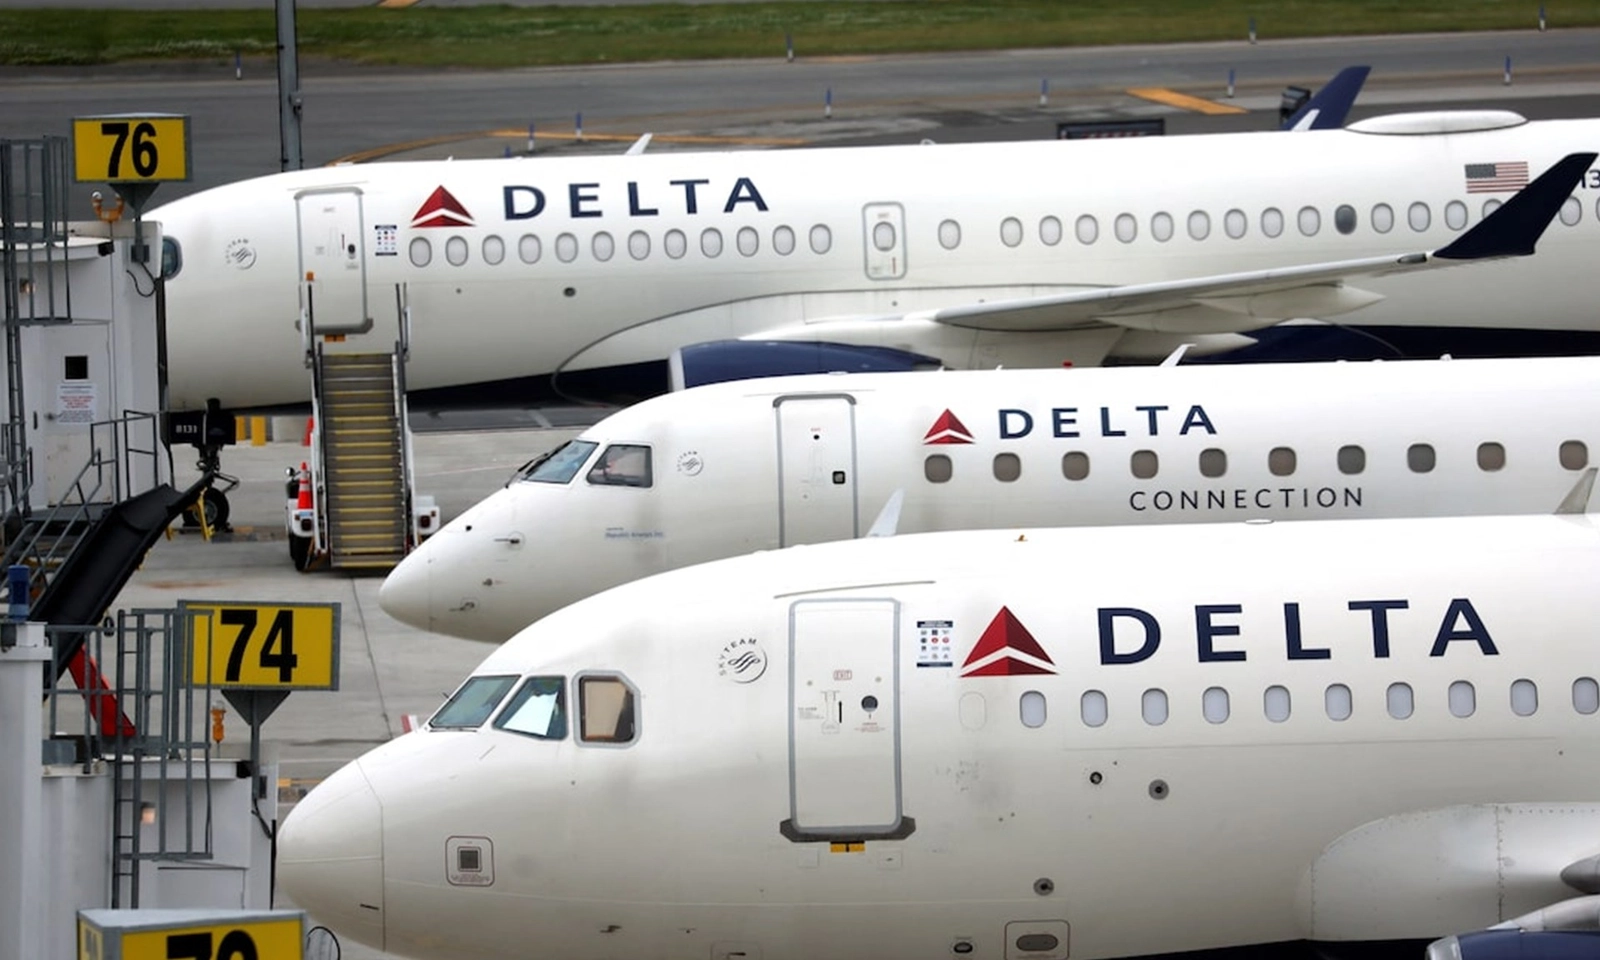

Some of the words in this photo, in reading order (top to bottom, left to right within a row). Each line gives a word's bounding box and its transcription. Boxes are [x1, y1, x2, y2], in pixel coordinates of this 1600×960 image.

[101, 123, 158, 177] 76
[504, 178, 768, 220] DELTA
[999, 406, 1216, 438] DELTA
[1129, 488, 1363, 511] CONNECTION
[221, 609, 297, 682] 74
[1098, 599, 1499, 665] DELTA
